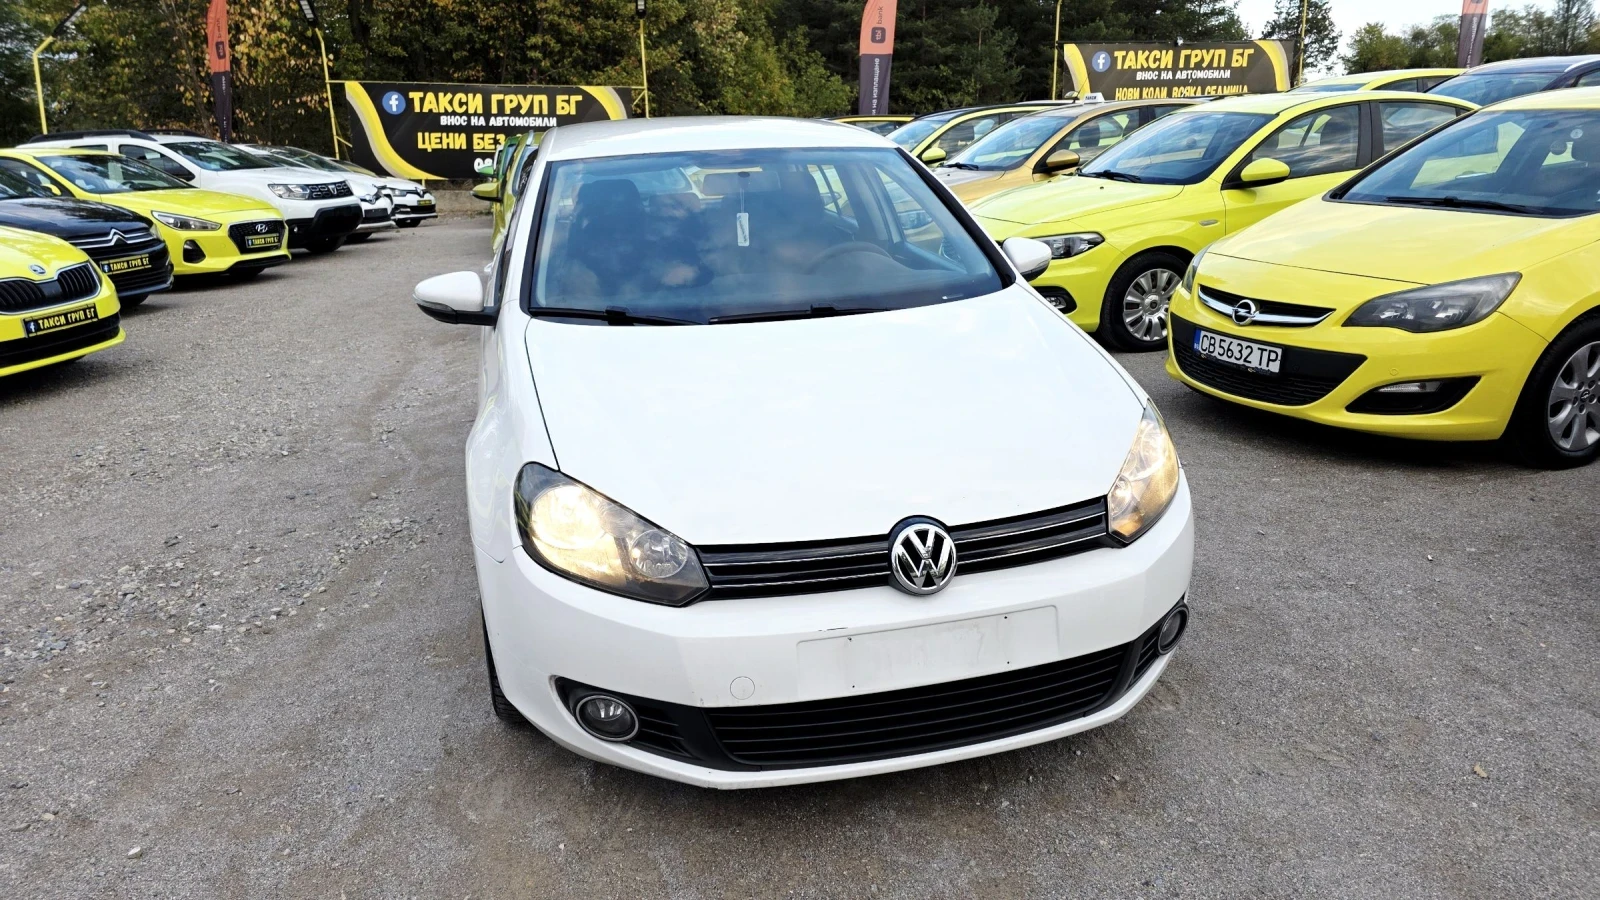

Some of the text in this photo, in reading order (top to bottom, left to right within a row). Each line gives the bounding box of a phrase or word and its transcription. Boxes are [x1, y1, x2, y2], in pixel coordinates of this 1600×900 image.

[876, 6, 884, 25] bank
[1113, 49, 1174, 70] ТАКСИ
[1178, 49, 1226, 69] ГРУП
[1230, 48, 1255, 68] БГ
[1136, 69, 1231, 81] ВНОС НА АВТОМОБИЛИ
[1115, 87, 1140, 101] НОВИ
[1171, 86, 1202, 98] ВСЯКА
[408, 91, 484, 114] ТАКСИ
[491, 92, 549, 115] ГРУП
[556, 94, 583, 116] БГ
[440, 115, 558, 127] ВНОС НА АВТОМОБИЛИ
[417, 131, 506, 152] ЦЕНИ БЕЗ
[110, 260, 128, 271] ТАКСИ
[128, 258, 142, 268] ГРУП
[142, 257, 149, 265] БГ
[38, 315, 66, 330] ТАКСИ
[67, 310, 86, 324] ГРУП
[86, 308, 95, 318] БГ
